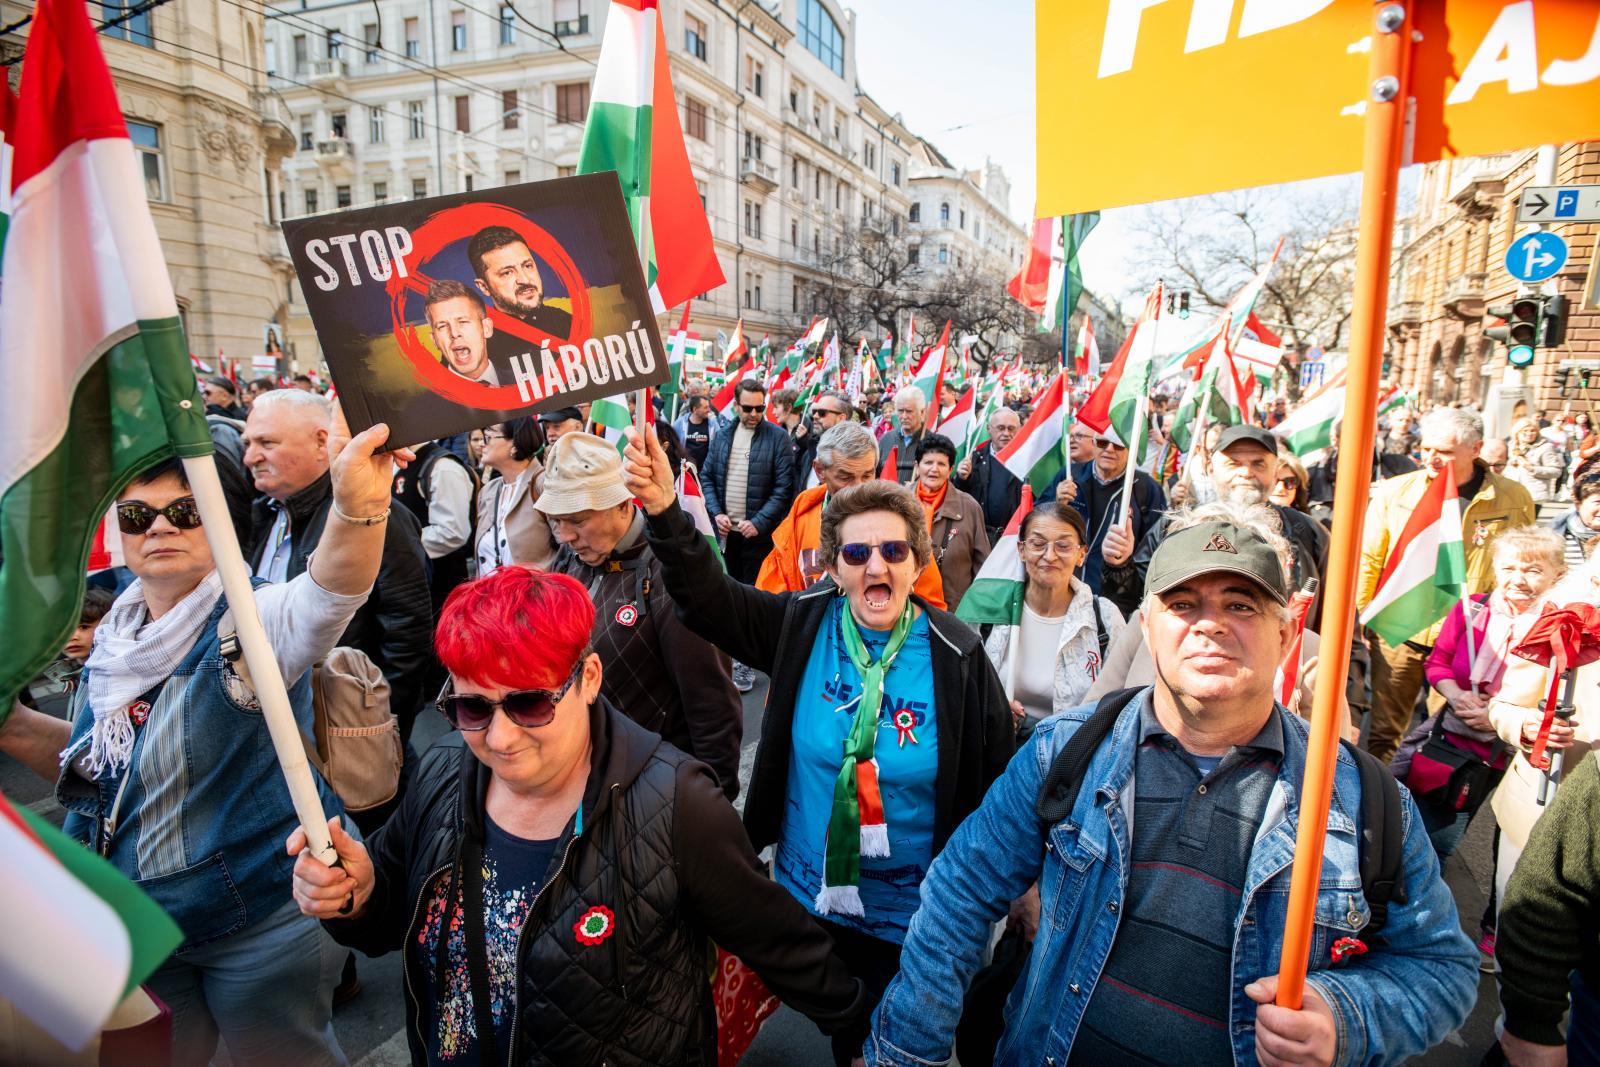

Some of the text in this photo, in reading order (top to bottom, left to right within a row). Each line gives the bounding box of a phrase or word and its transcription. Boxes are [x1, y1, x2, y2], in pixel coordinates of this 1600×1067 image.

[305, 226, 413, 292] STOP
[509, 320, 657, 403] HÁBORÚ
[824, 677, 928, 727] JENS
